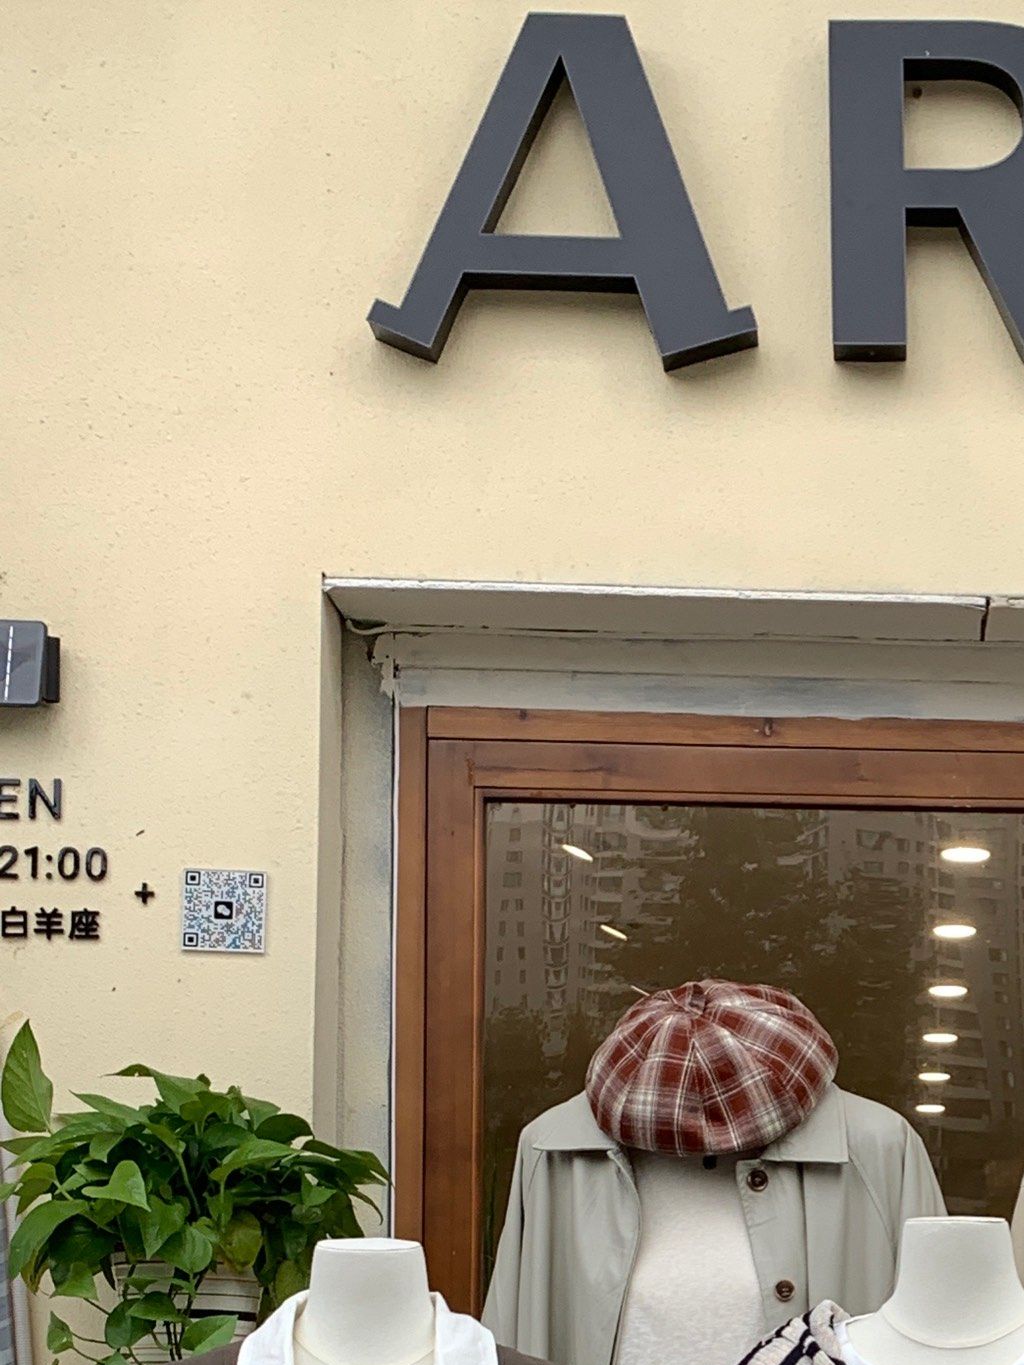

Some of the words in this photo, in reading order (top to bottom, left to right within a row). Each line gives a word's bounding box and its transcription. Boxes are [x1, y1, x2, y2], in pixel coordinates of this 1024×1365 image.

[0, 845, 108, 881] 21:00
[1, 905, 100, 940] 白羊座
